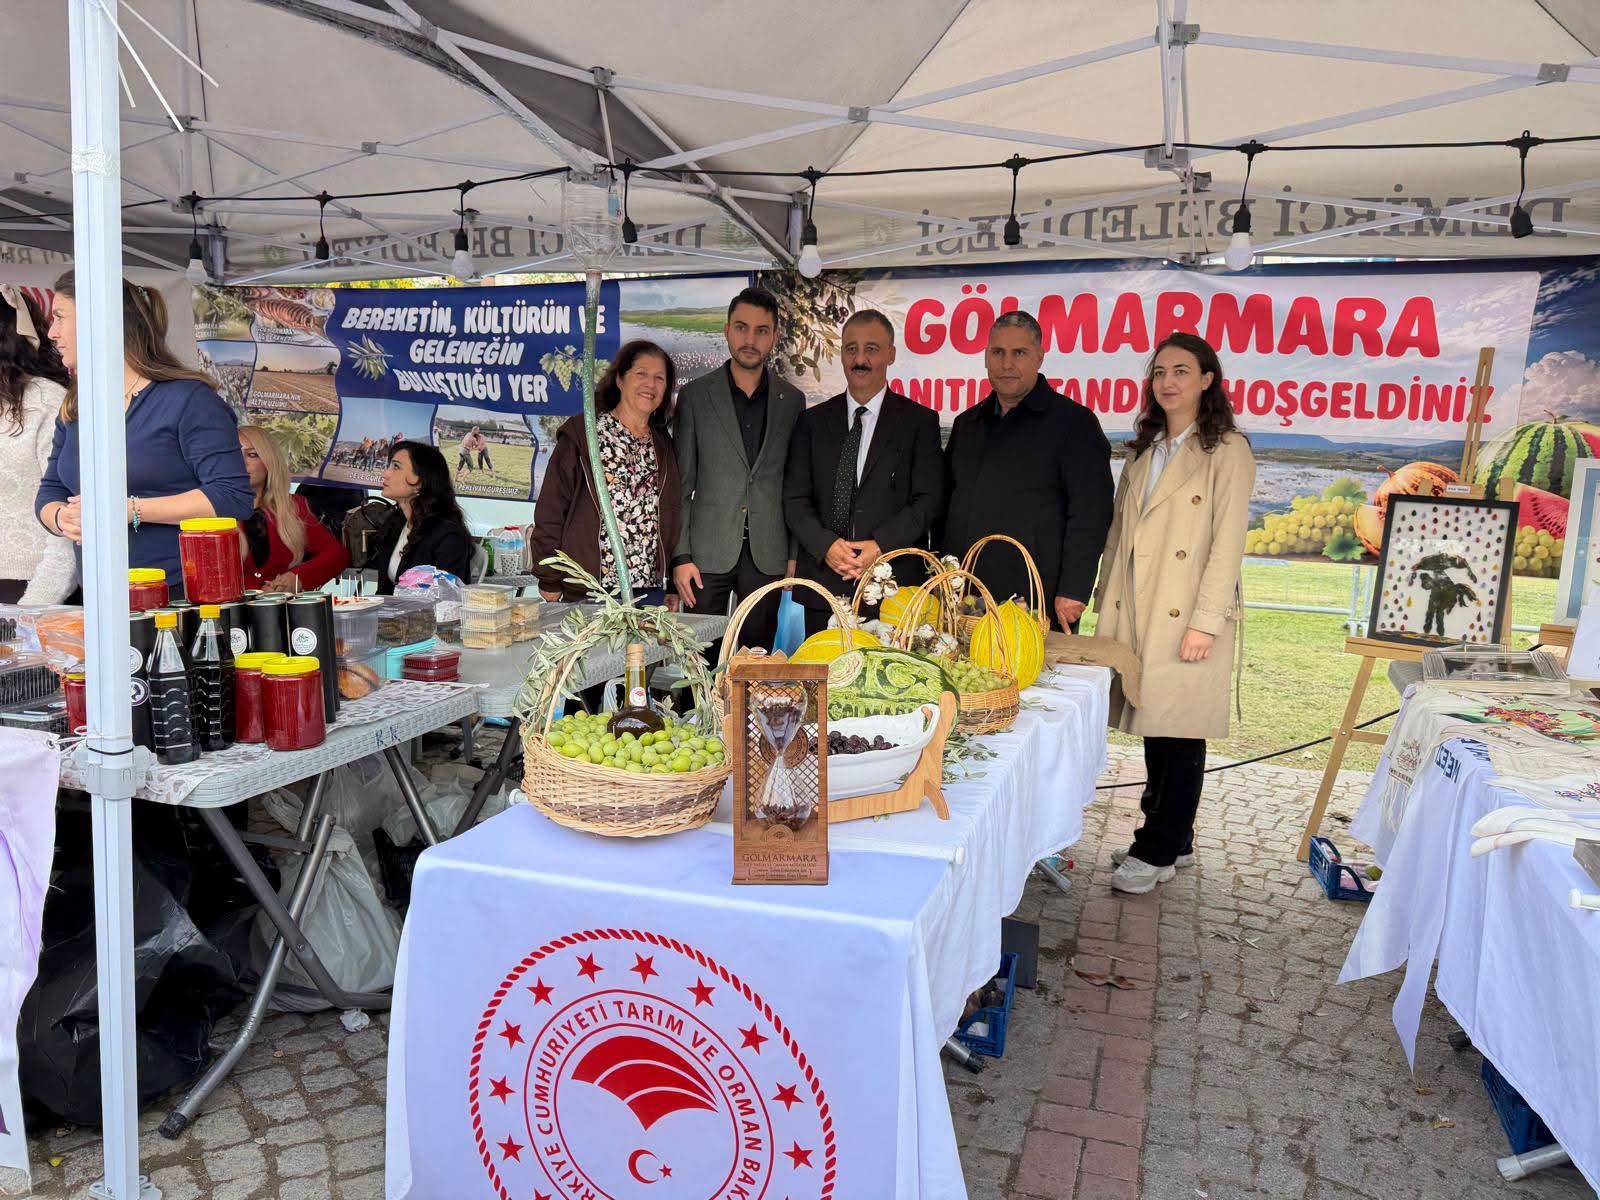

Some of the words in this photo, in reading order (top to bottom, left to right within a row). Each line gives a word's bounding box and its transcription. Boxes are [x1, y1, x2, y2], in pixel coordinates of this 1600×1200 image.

[341, 300, 457, 338] BEREKETİN,
[463, 299, 570, 334] KÜLTÜRÜN
[904, 283, 1440, 358] GÖMARMARA
[409, 335, 525, 366] GELENEĞİN
[507, 373, 549, 403] YER
[612, 1000, 684, 1036] TARIM
[534, 1000, 608, 1136] CUMHURİYETİ
[691, 1034, 719, 1063] VE
[717, 1064, 763, 1151] ORMAN
[544, 1143, 597, 1200] RKİYE
